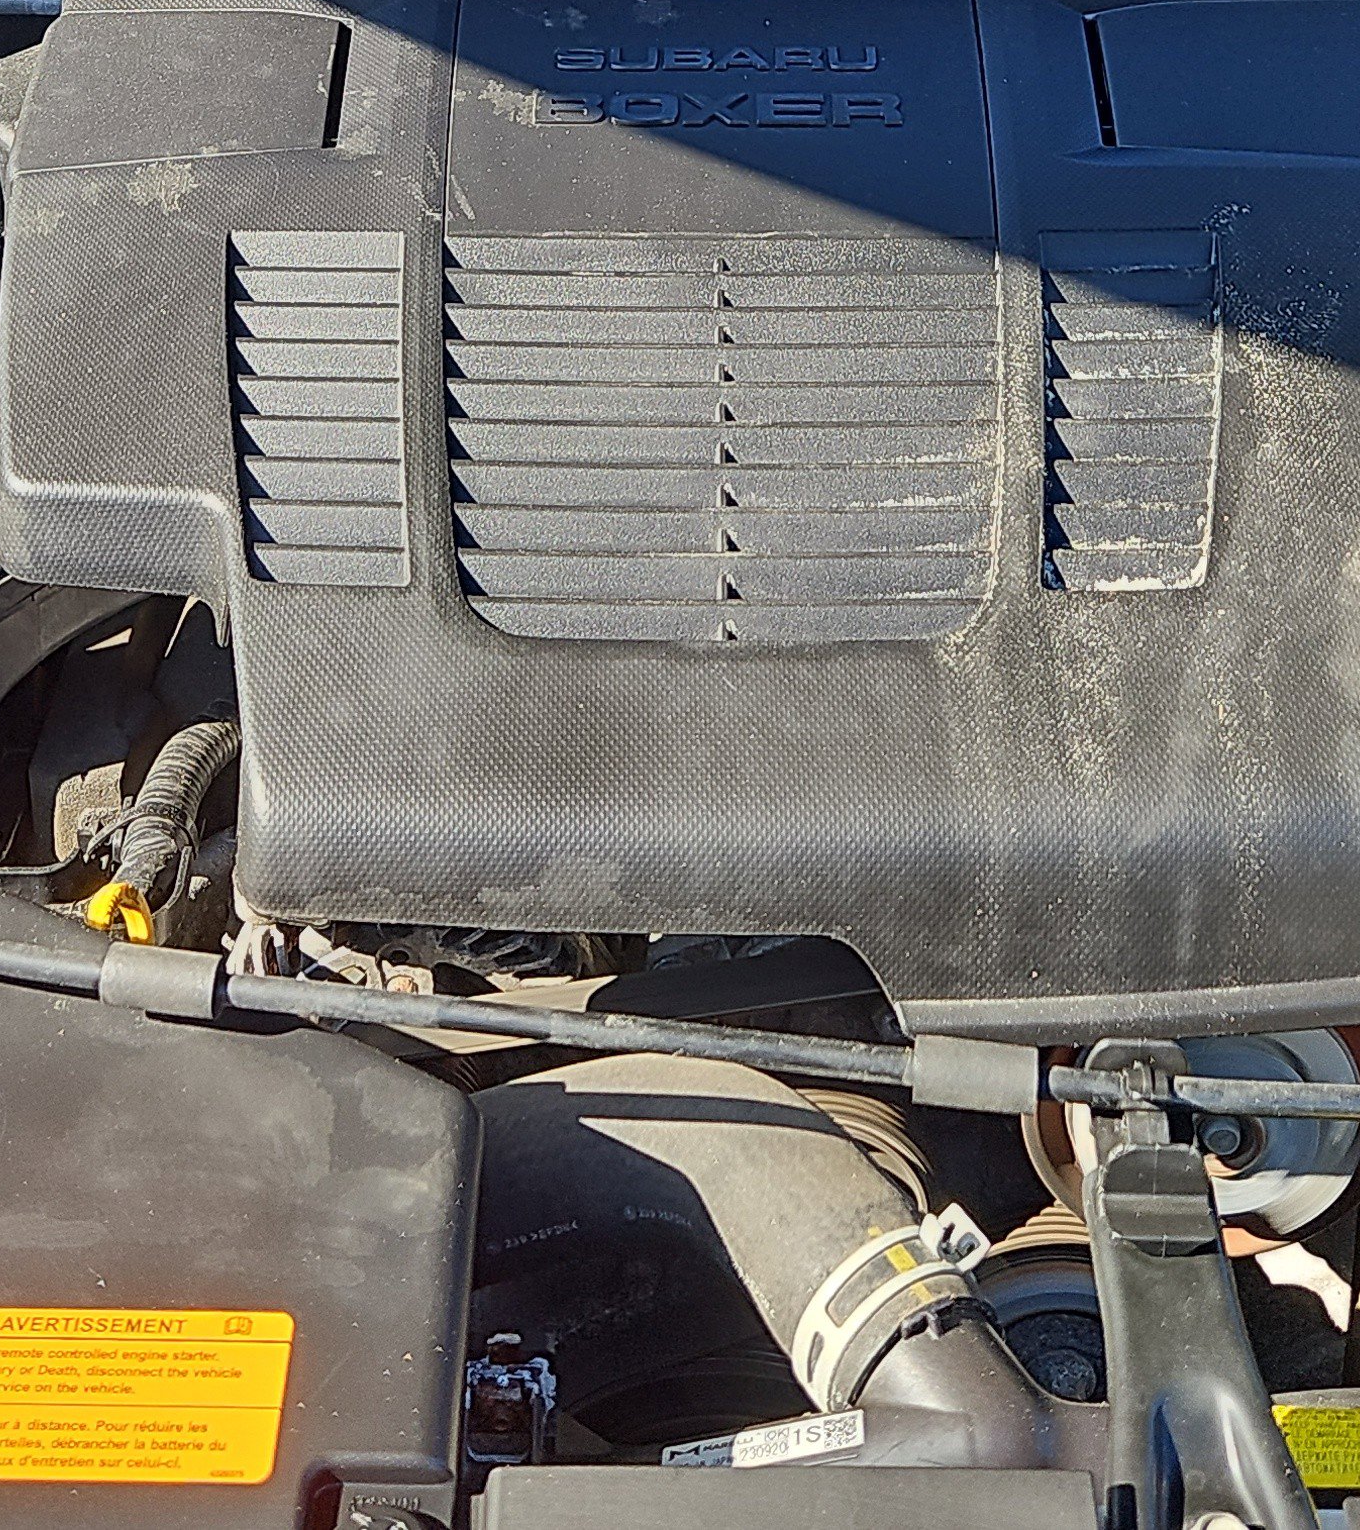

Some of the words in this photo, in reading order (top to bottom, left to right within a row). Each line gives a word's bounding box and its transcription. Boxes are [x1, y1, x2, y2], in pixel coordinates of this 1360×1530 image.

[554, 46, 879, 73] SUBARU
[533, 90, 904, 128] BOXER
[0, 1316, 186, 1333] AVERTISSEMENT
[47, 1349, 118, 1359] controlled
[121, 1351, 168, 1362] engine
[18, 1366, 33, 1375] or
[37, 1364, 82, 1375] Death,
[85, 1367, 163, 1376] disconnect
[166, 1368, 189, 1377] the
[193, 1369, 242, 1378] vehicle
[34, 1384, 52, 1392] on
[56, 1384, 78, 1392] the
[82, 1384, 133, 1393] vehicle.
